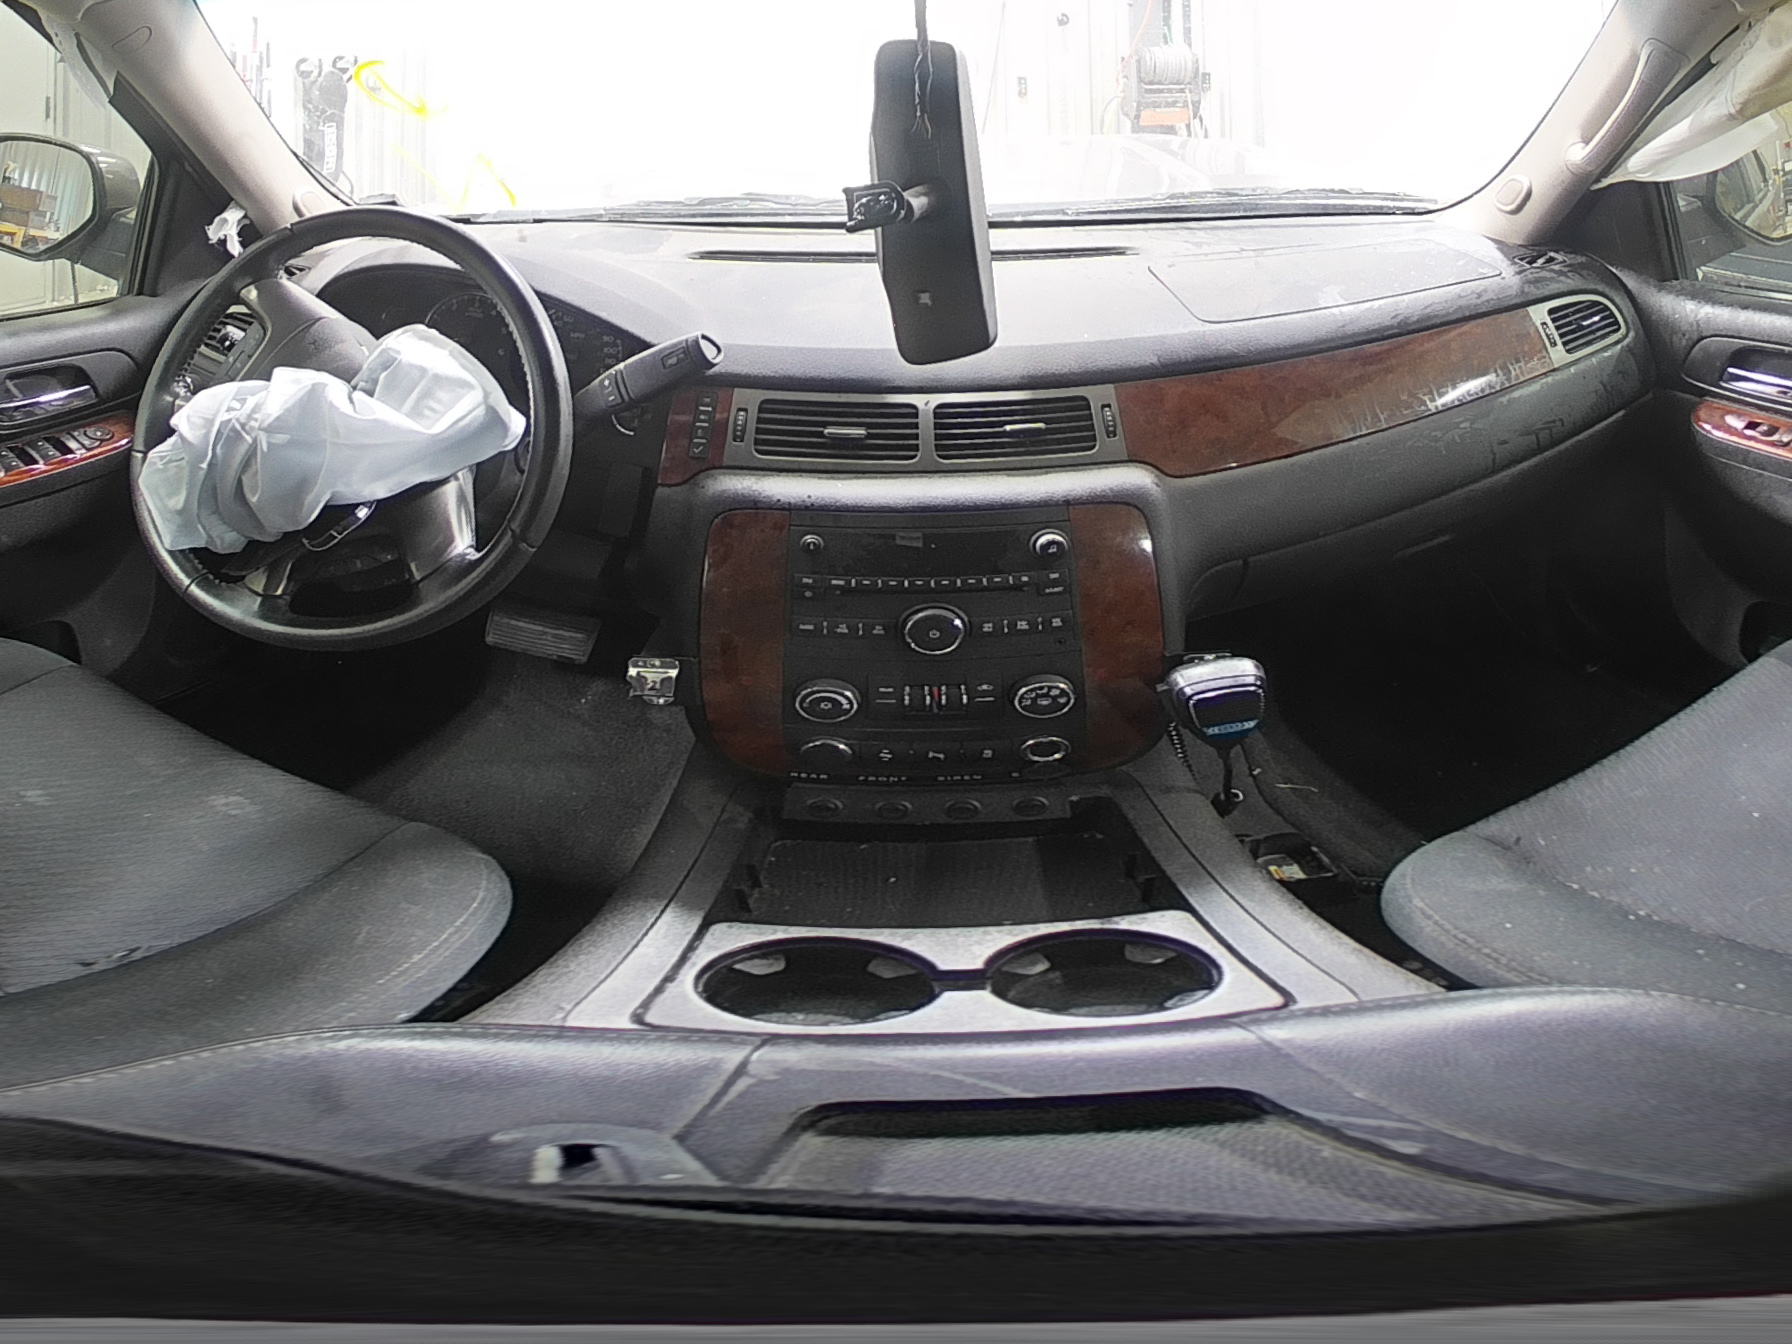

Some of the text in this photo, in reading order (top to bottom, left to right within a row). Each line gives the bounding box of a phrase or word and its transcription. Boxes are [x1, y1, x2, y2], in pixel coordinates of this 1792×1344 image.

[789, 770, 984, 783] REAR FRONT SIREN
